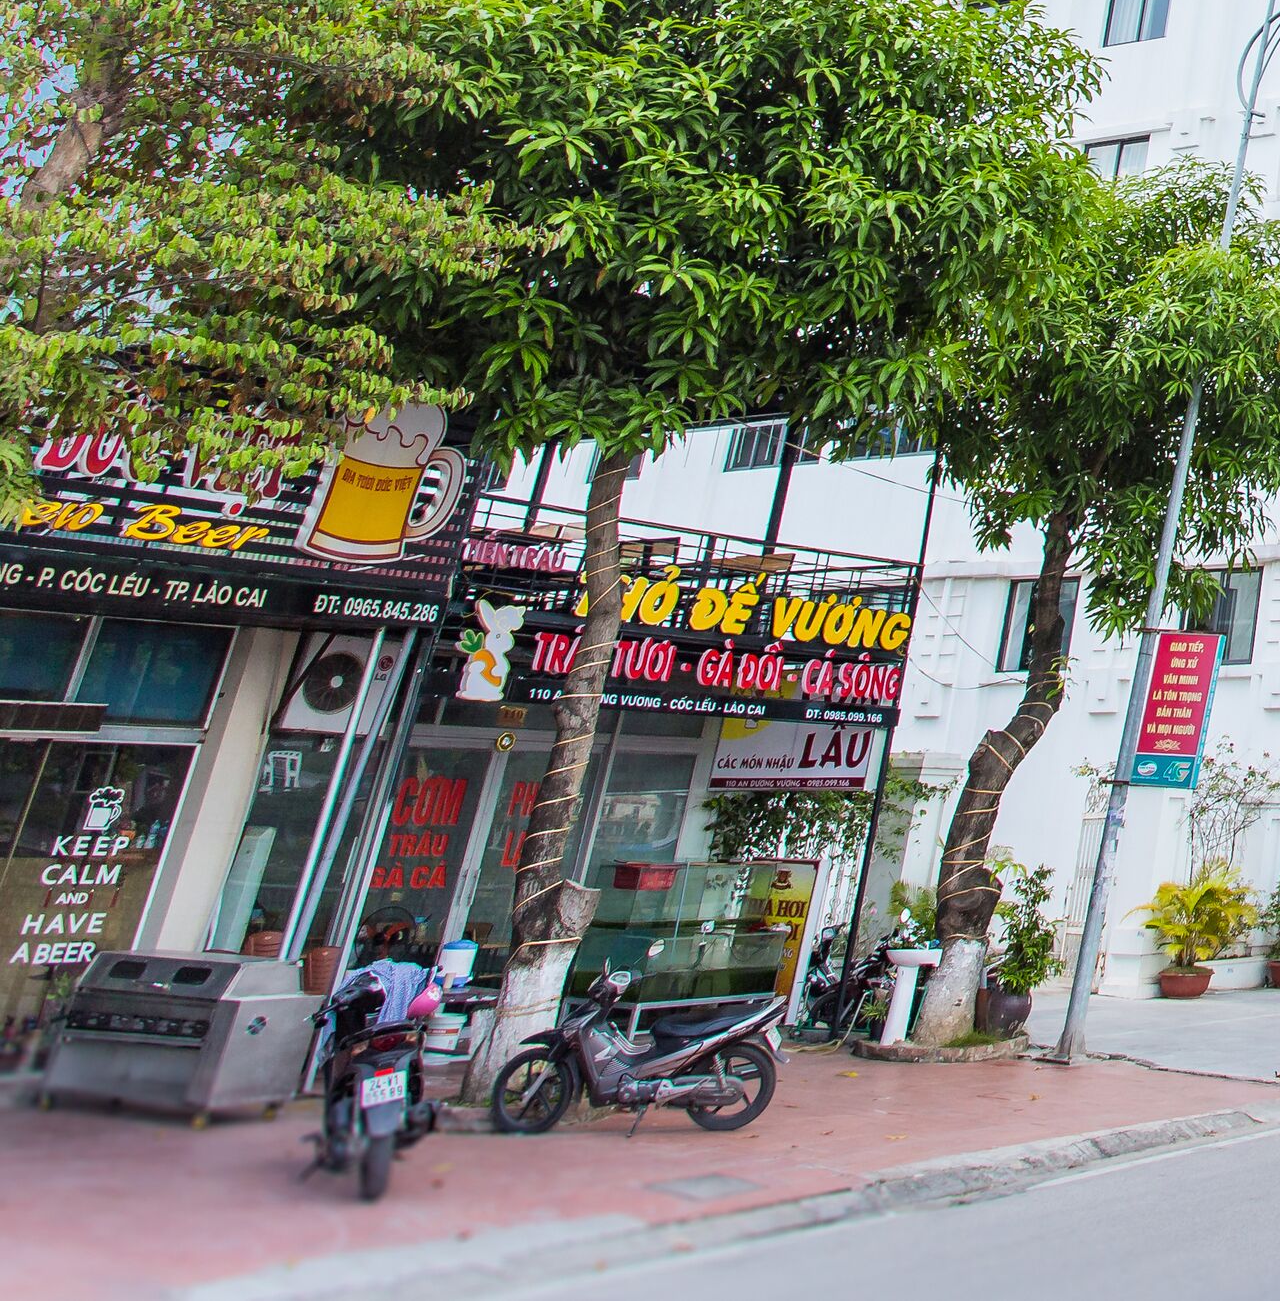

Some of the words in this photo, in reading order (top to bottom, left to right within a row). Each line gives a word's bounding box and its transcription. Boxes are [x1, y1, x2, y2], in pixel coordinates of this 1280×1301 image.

[125, 503, 270, 550] Beer
[37, 567, 55, 588] P.
[164, 580, 189, 602] TP.
[235, 586, 269, 608] CAI
[314, 594, 342, 615] ĐT:
[343, 597, 441, 623] 0965.845.286
[689, 572, 767, 635] ĐẾ
[772, 593, 912, 651] VƯƠNG
[1170, 642, 1187, 652] GIAO
[374, 672, 387, 682] LG
[612, 637, 678, 682] TƯƠI
[696, 639, 735, 689] GÀ
[736, 641, 785, 691] ĐỒI
[801, 649, 836, 697] CÁ
[836, 652, 900, 701] SÔNG
[1178, 674, 1198, 685] MINH
[529, 688, 551, 700] 110
[620, 693, 661, 709] VƯƠNG
[747, 704, 766, 716] CAI
[1152, 689, 1162, 700] LÀ
[1178, 691, 1203, 703] TRỌNG
[823, 709, 883, 723] 0985.099.166
[1146, 721, 1156, 733] VÀ
[717, 753, 737, 769] CÁC
[740, 753, 764, 769] MÓN
[765, 754, 796, 774] NHẬU
[1163, 761, 1192, 782] 4G
[392, 774, 469, 826] CƠM
[51, 835, 131, 857] KEEP
[41, 863, 123, 886] CALM
[369, 861, 403, 889] GÀ
[410, 860, 447, 889] CÁ
[55, 892, 89, 905] AND
[21, 912, 108, 935] HAVE
[9, 942, 31, 964] A
[32, 941, 97, 966] BEER
